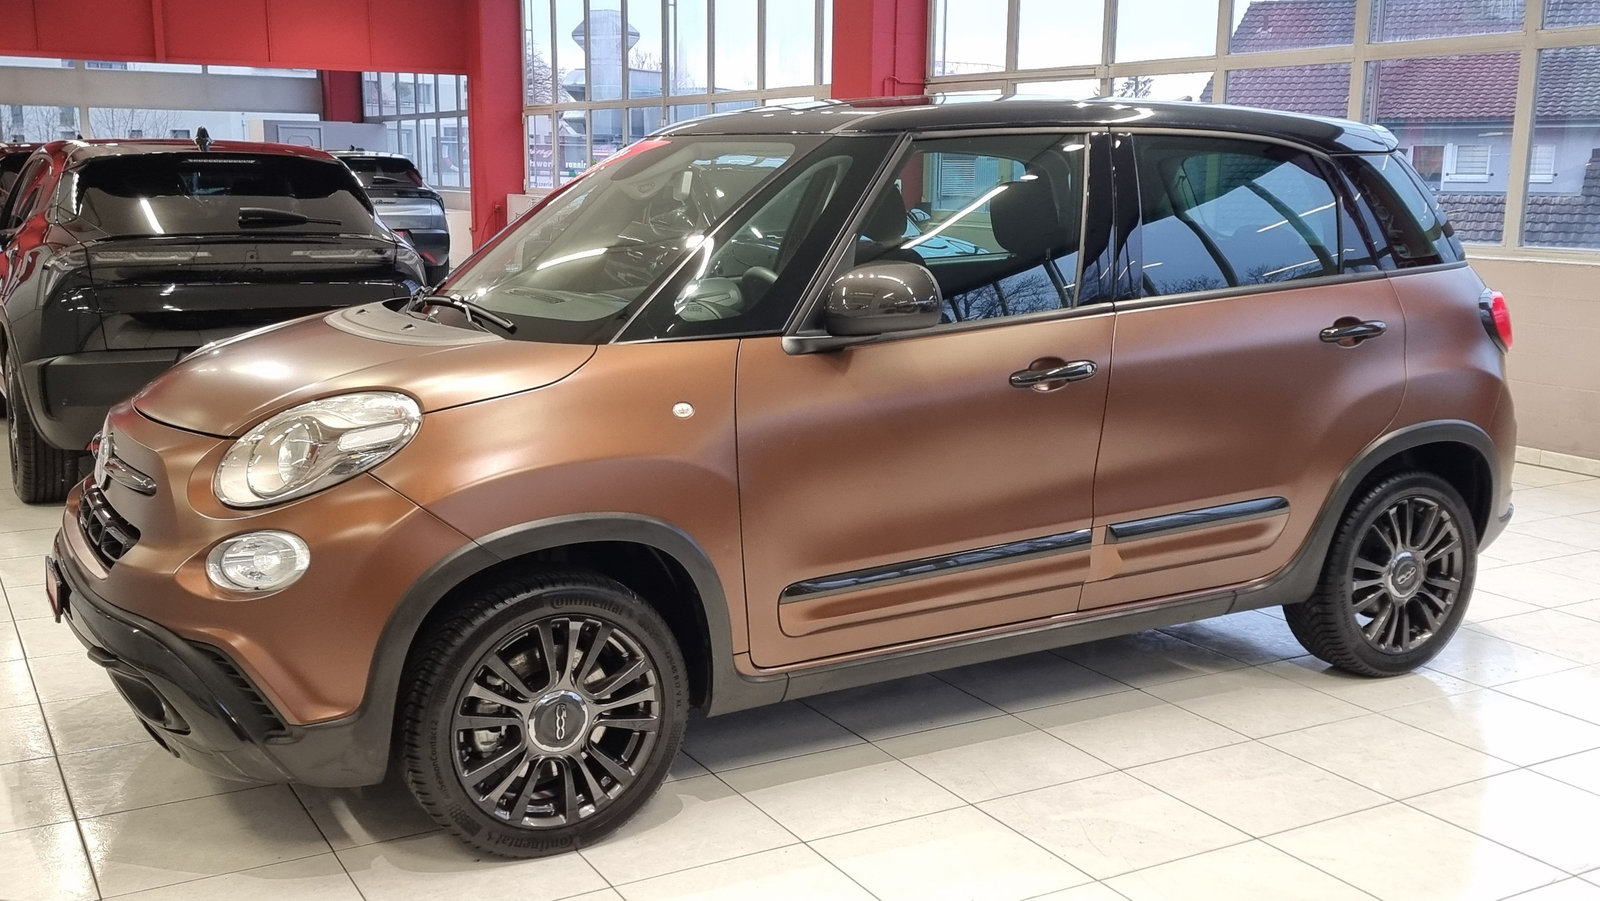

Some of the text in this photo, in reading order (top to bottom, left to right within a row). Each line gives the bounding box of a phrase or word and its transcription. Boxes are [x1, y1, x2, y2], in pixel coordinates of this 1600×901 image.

[550, 596, 625, 616] Continental
[556, 703, 567, 740] 500
[496, 833, 574, 851] Continental
